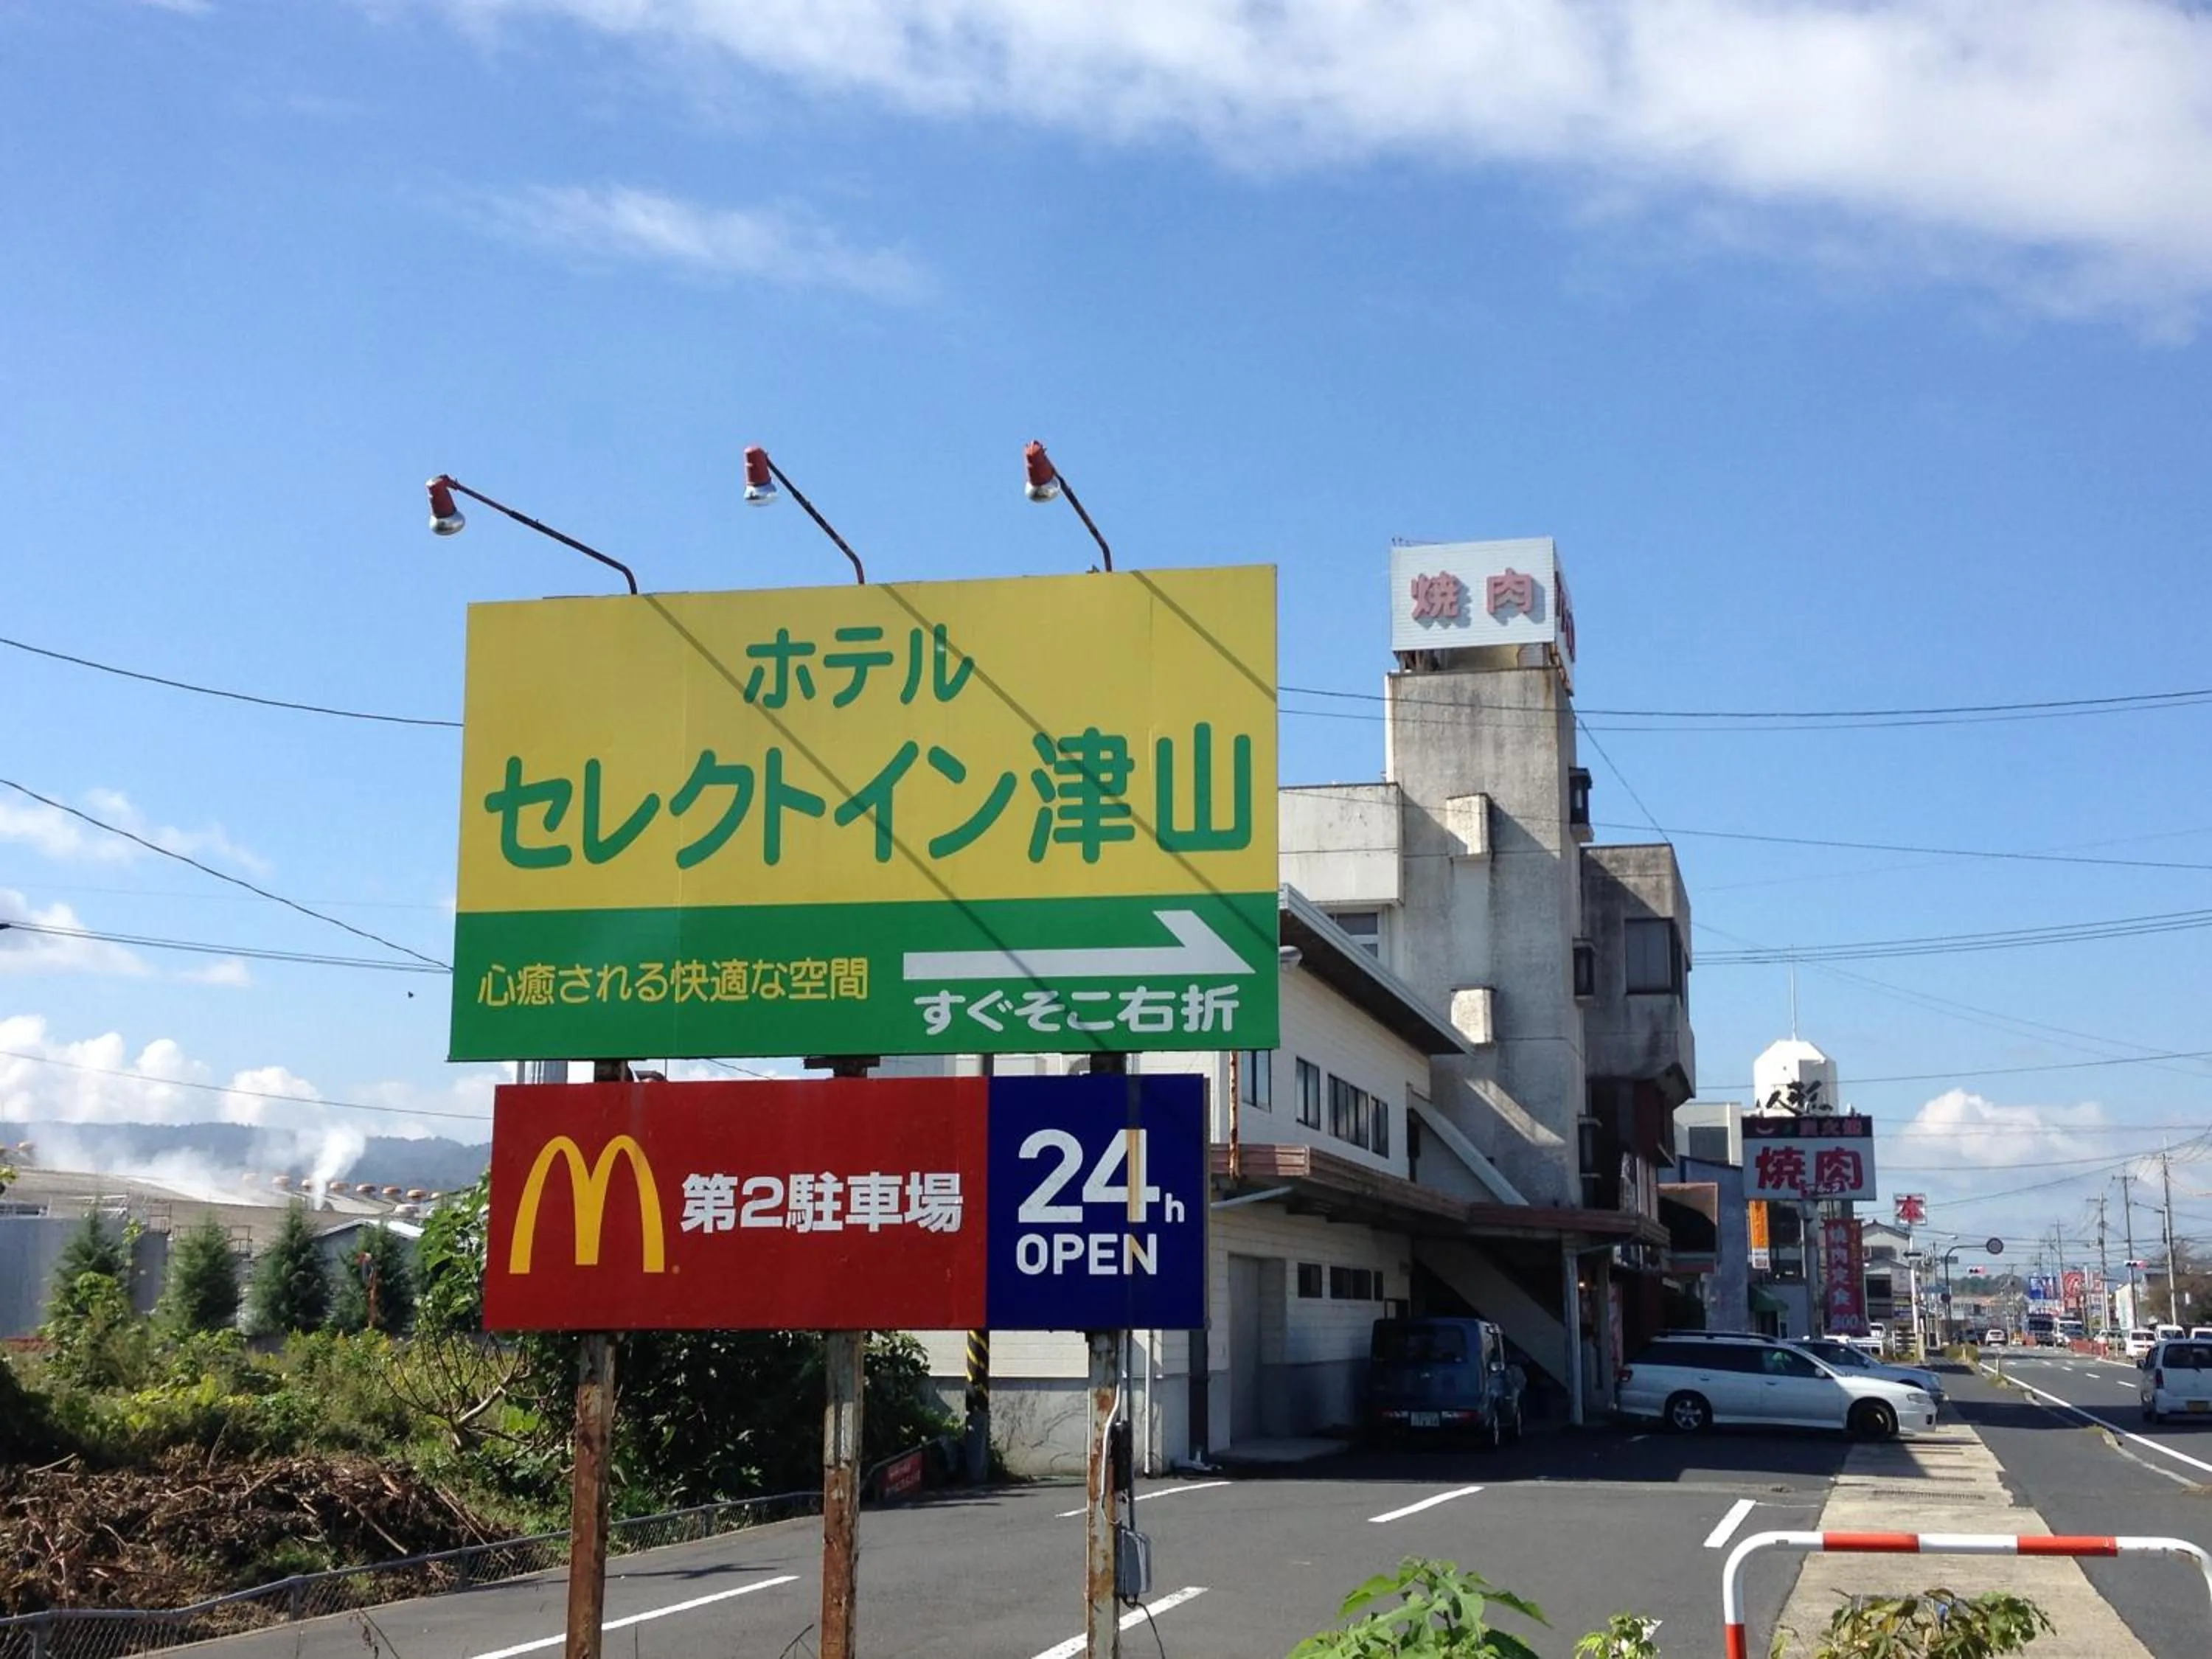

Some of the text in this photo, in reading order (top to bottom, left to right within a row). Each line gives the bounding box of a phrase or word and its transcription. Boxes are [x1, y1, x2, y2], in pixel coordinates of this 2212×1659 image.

[1411, 567, 1533, 619] 焼肉
[743, 624, 974, 709] ホテル
[484, 722, 1253, 870] セレクトイン津山
[477, 957, 869, 1007] 心癒される快適な空間
[914, 983, 1239, 1035] すぐそこ右折
[1755, 1145, 1864, 1193] 焼肉
[681, 1172, 964, 1234] 第2駐車場
[1015, 1234, 1158, 1275] OPEN
